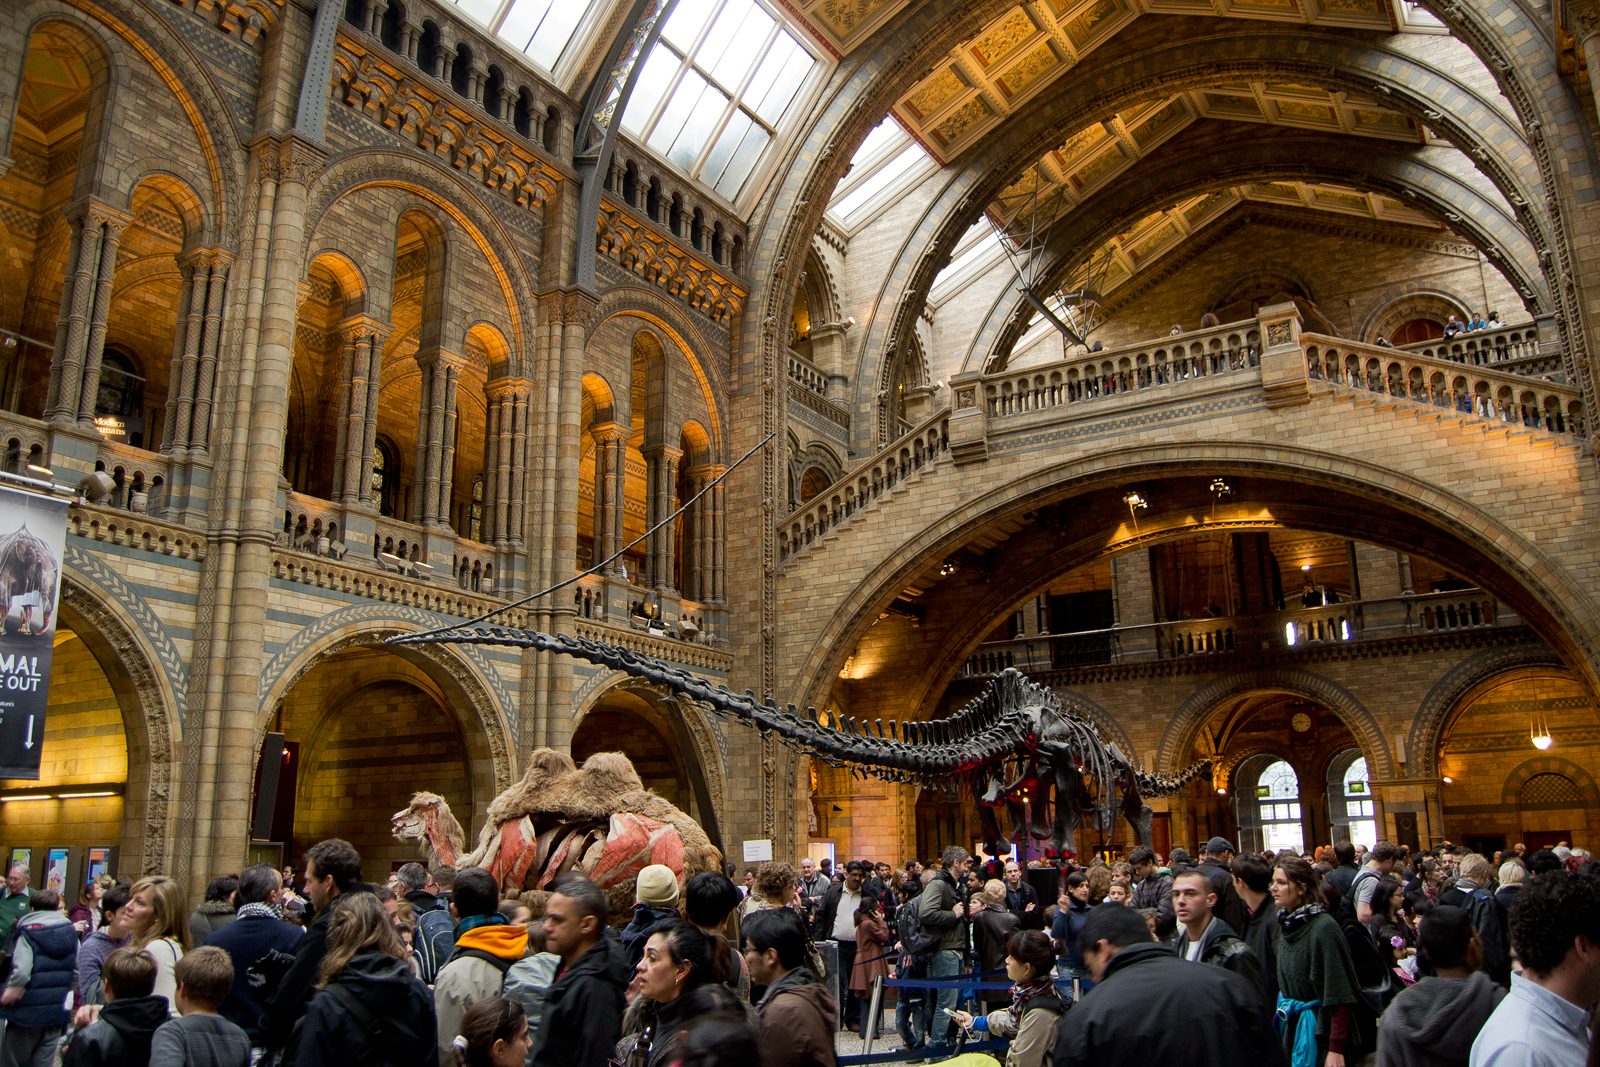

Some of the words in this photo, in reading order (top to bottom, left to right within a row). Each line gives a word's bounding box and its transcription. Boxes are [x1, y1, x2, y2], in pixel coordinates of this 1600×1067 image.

[94, 417, 125, 427] Modern
[96, 427, 126, 435] umans
[8, 676, 41, 691] OUT
